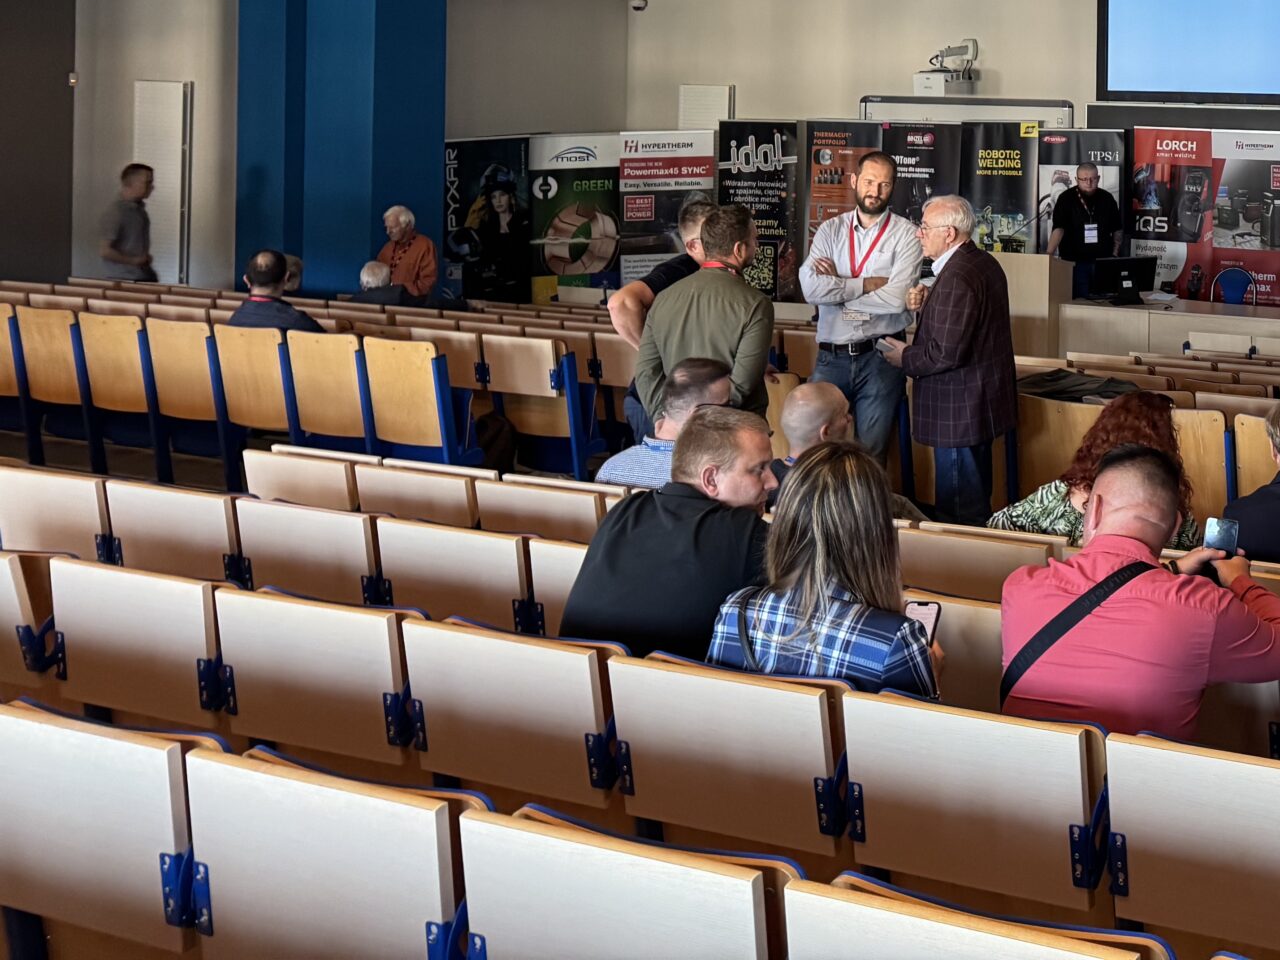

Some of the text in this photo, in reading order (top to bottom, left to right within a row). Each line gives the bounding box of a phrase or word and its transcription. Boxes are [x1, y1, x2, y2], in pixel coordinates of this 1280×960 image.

[641, 142, 694, 150] HYPERTHERM
[1156, 139, 1197, 152] LORCH
[978, 149, 1021, 159] ROBOTIC
[1088, 150, 1120, 162] TPS/i
[978, 159, 1021, 168] WELDING
[624, 166, 707, 176] Powermax45 SYNC
[573, 179, 613, 192] GREEN
